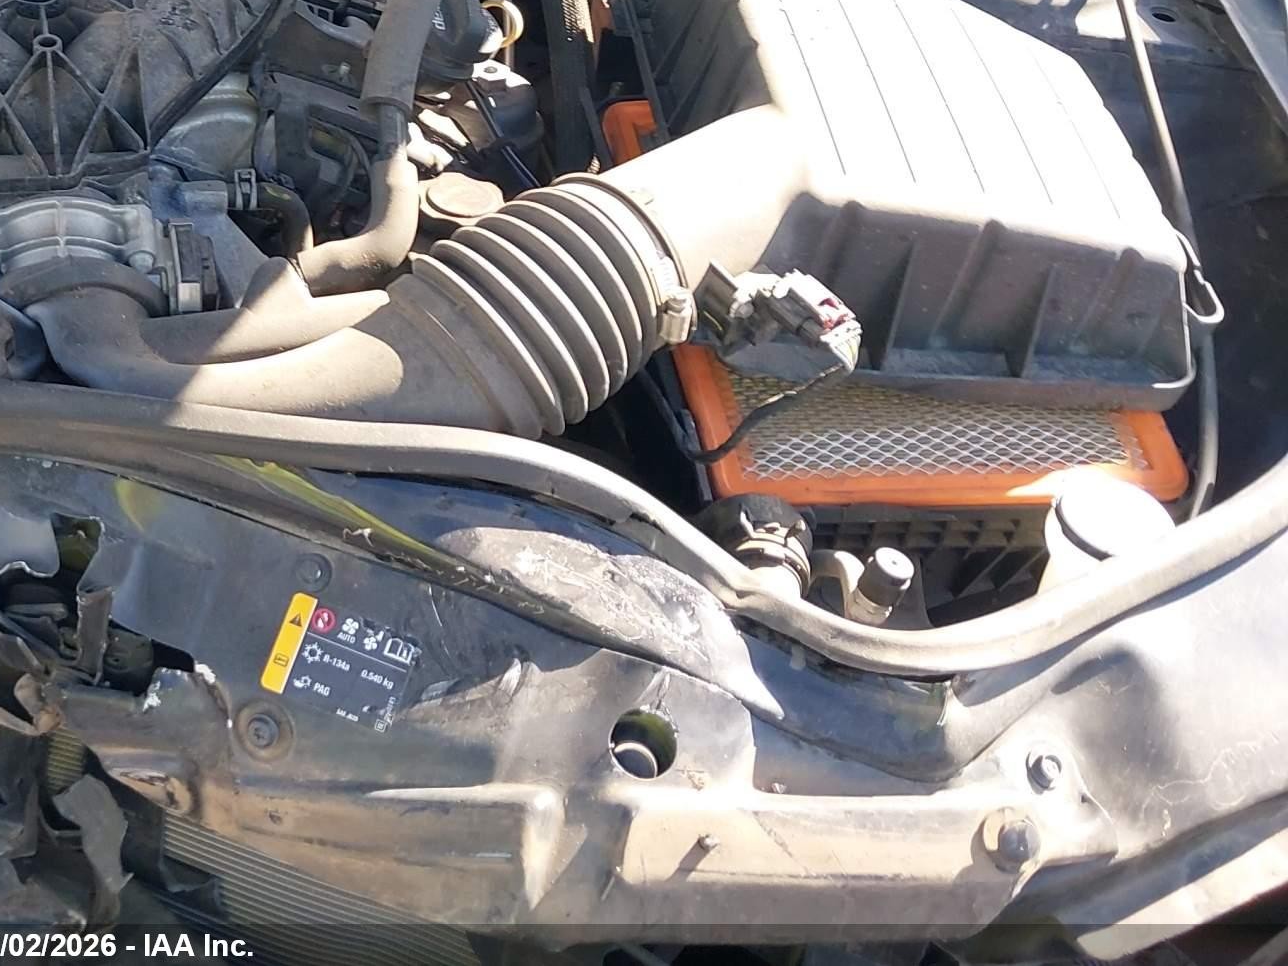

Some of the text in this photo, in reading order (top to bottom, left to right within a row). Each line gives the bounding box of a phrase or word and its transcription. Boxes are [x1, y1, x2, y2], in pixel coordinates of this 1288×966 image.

[337, 632, 356, 644] AUTO
[323, 654, 350, 671] R-134a
[361, 669, 394, 690] 0.540 kg
[313, 682, 331, 696] PAG
